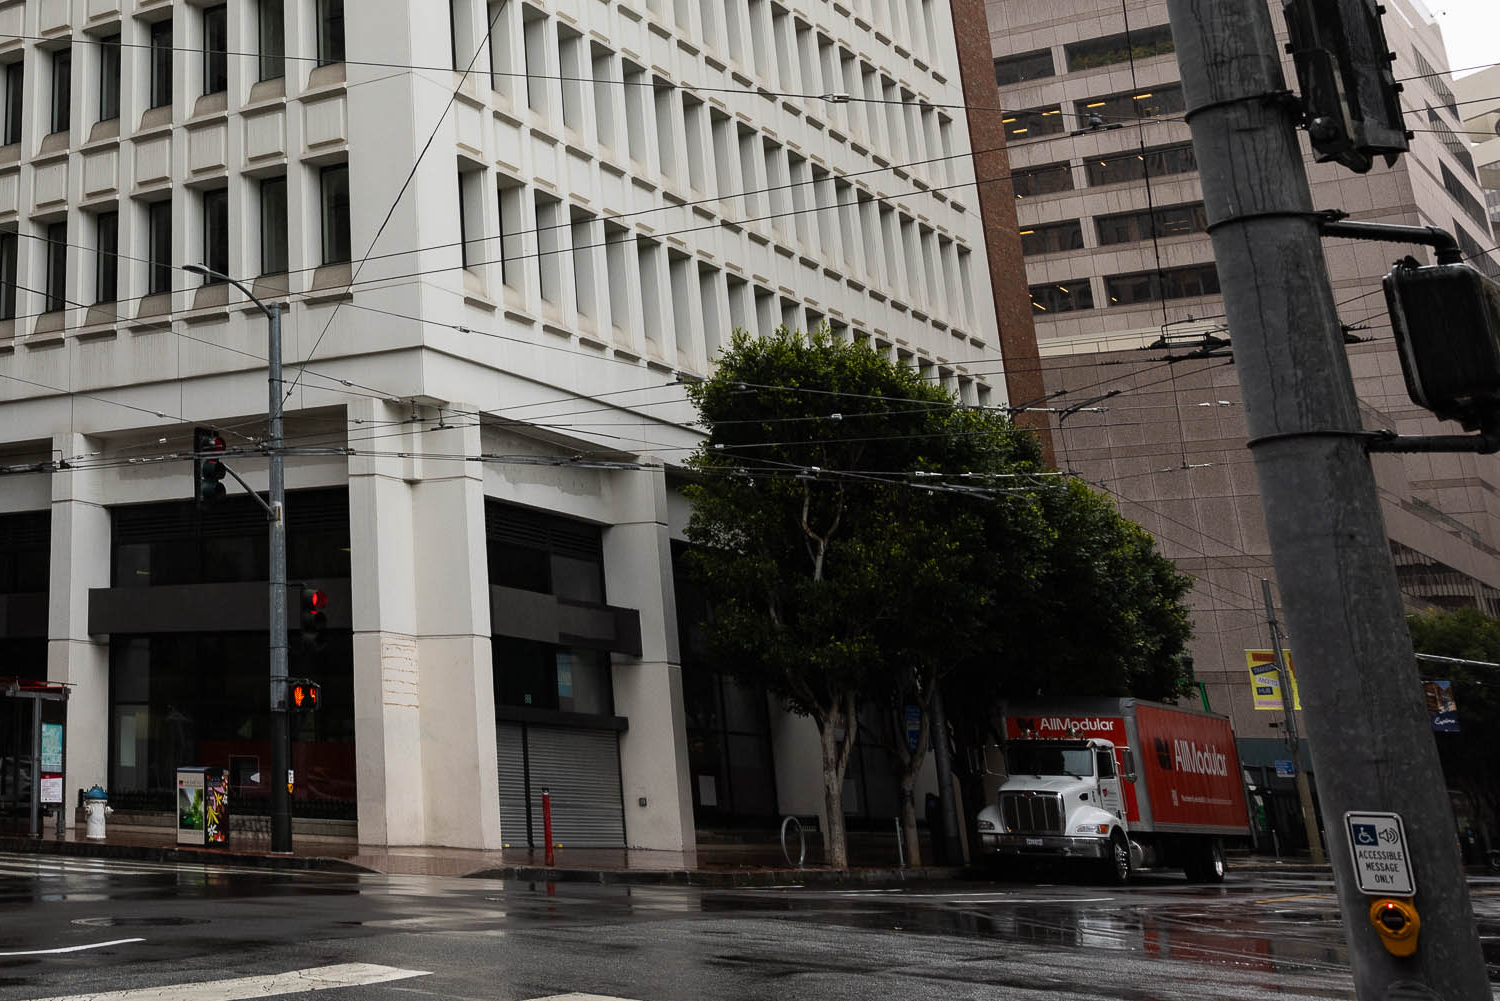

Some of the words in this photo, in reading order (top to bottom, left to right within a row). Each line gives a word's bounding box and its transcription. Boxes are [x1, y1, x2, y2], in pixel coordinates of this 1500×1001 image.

[1040, 718, 1114, 731] AllModular
[1174, 740, 1228, 777] AllModular
[1359, 850, 1403, 861] ACCESSIBLE
[1366, 862, 1400, 873] MESSAGE
[1374, 874, 1394, 884] ONLY
